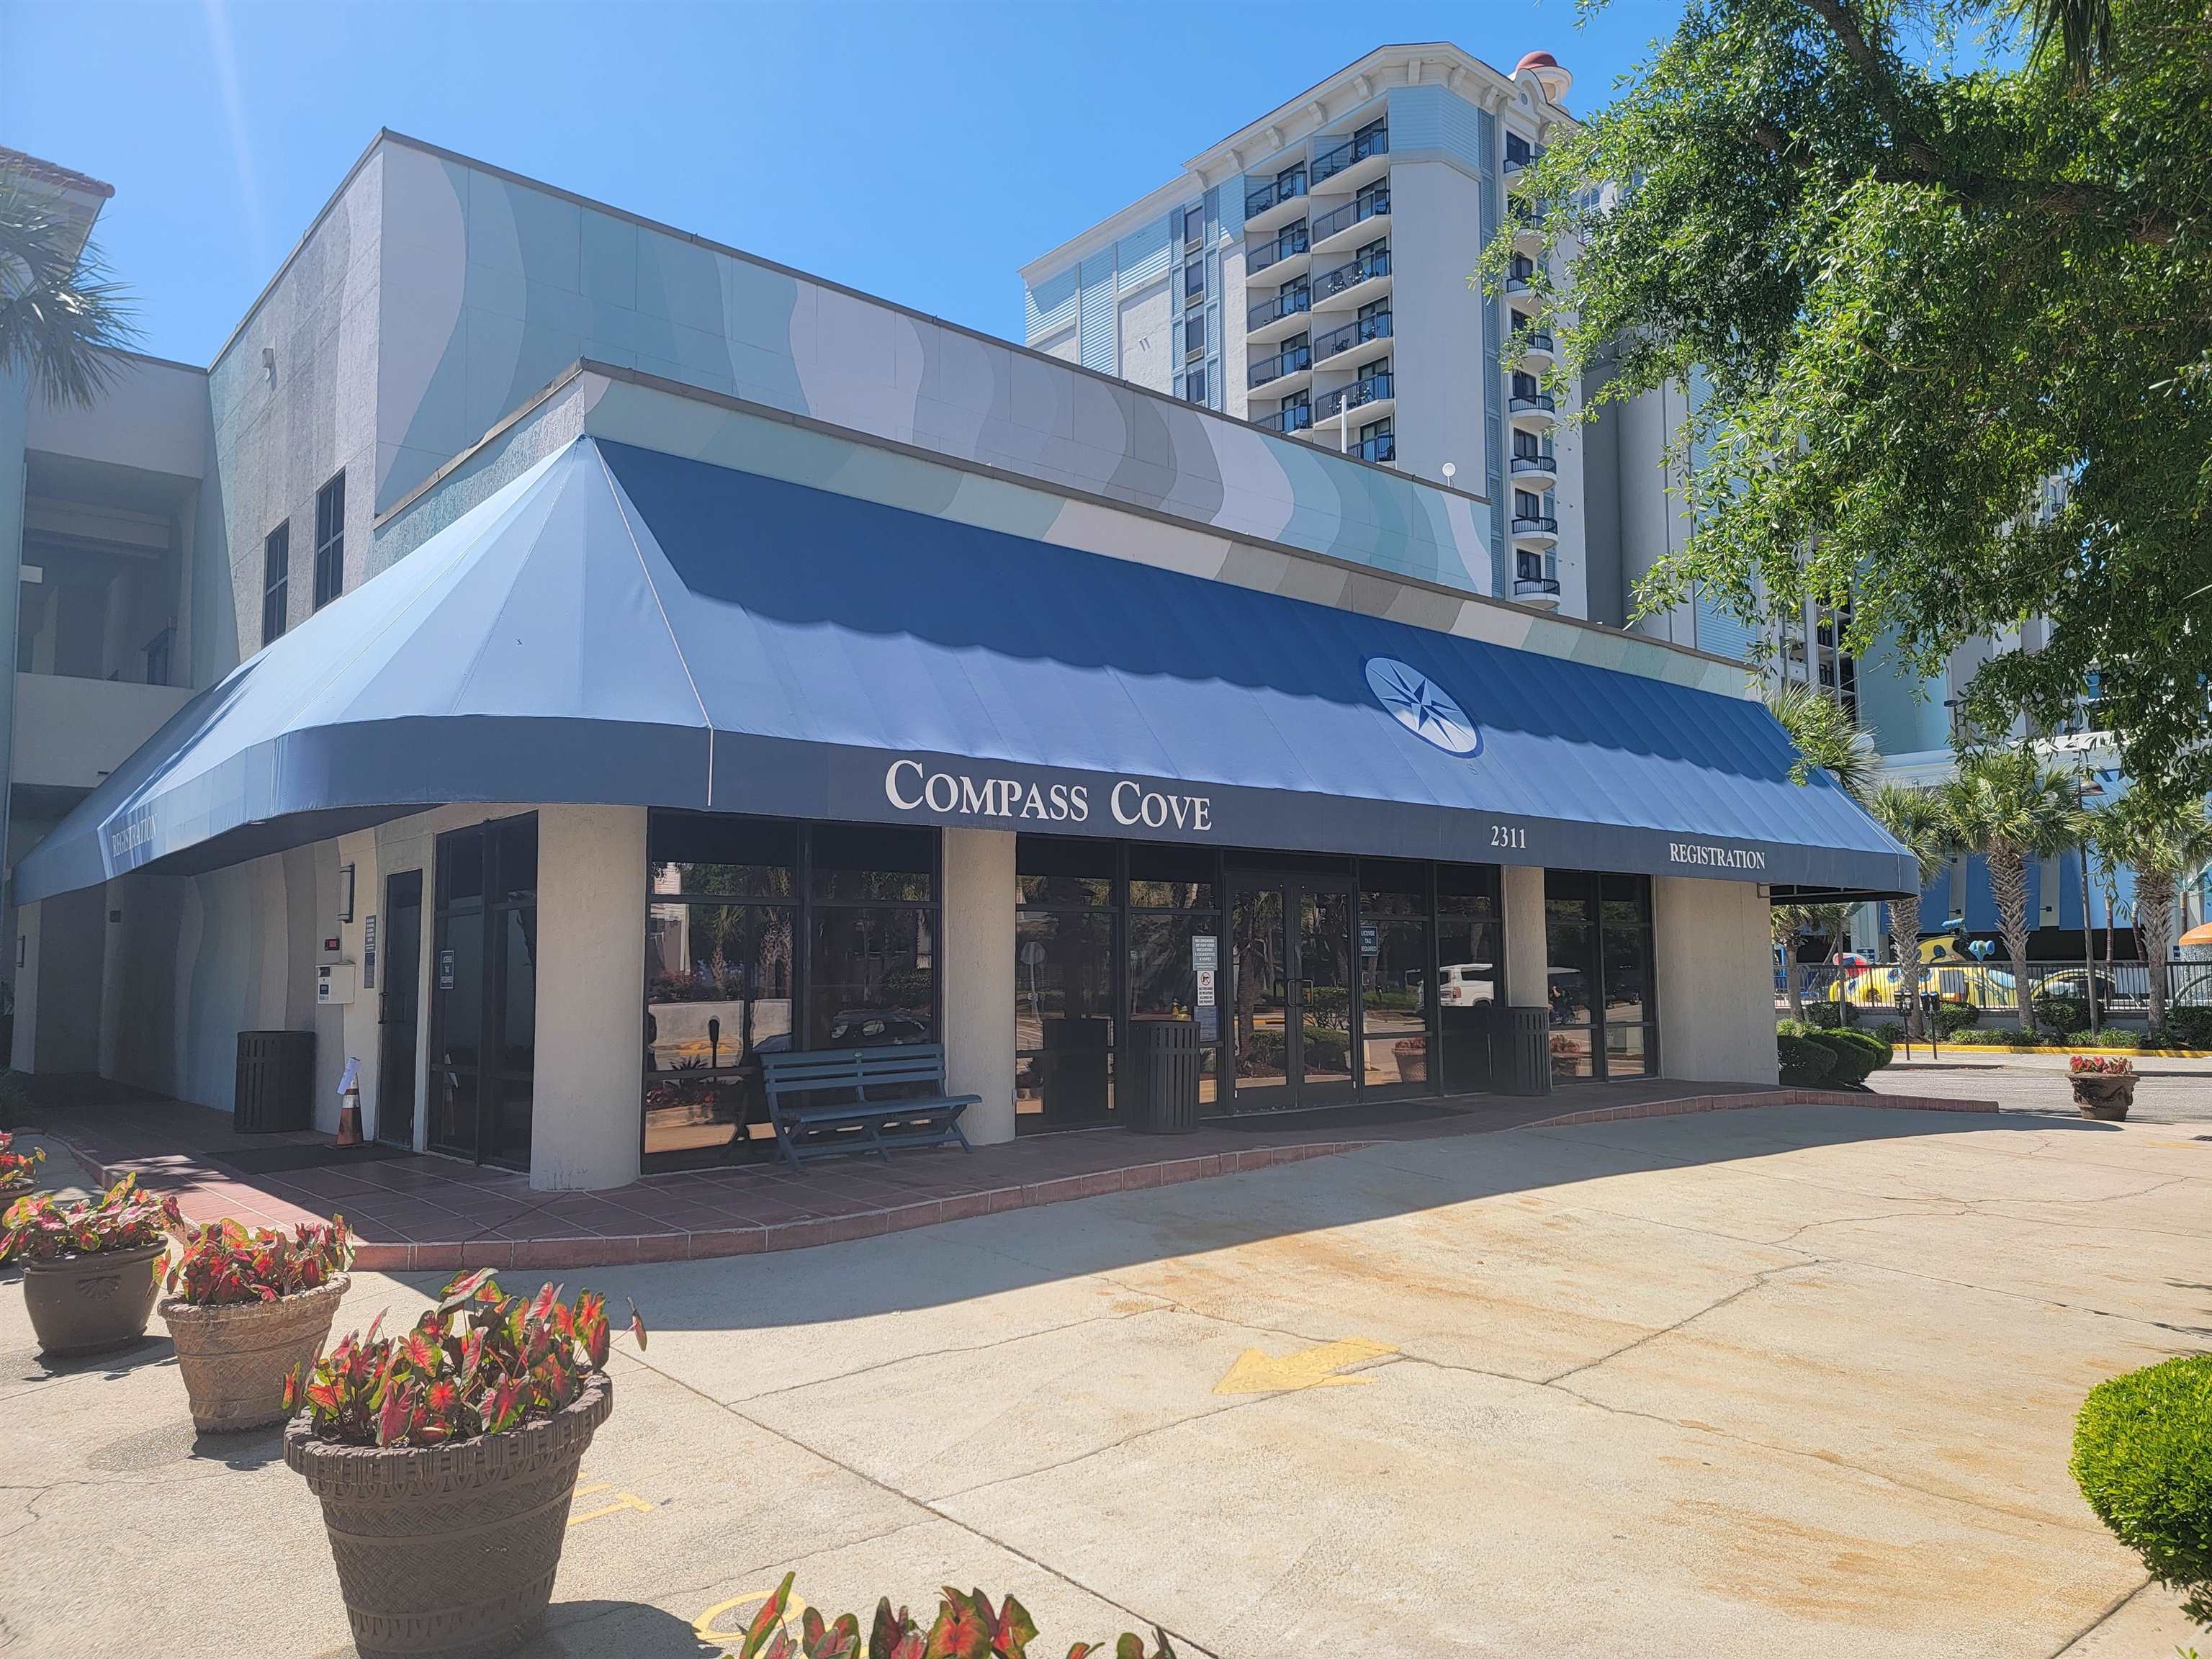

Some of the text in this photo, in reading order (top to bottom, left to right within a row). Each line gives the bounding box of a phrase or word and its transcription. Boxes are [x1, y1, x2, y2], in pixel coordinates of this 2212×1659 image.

[112, 813, 158, 858] REGISTRATION
[1491, 825, 1527, 848] 2311
[1669, 842, 1766, 869] REGISTRATION
